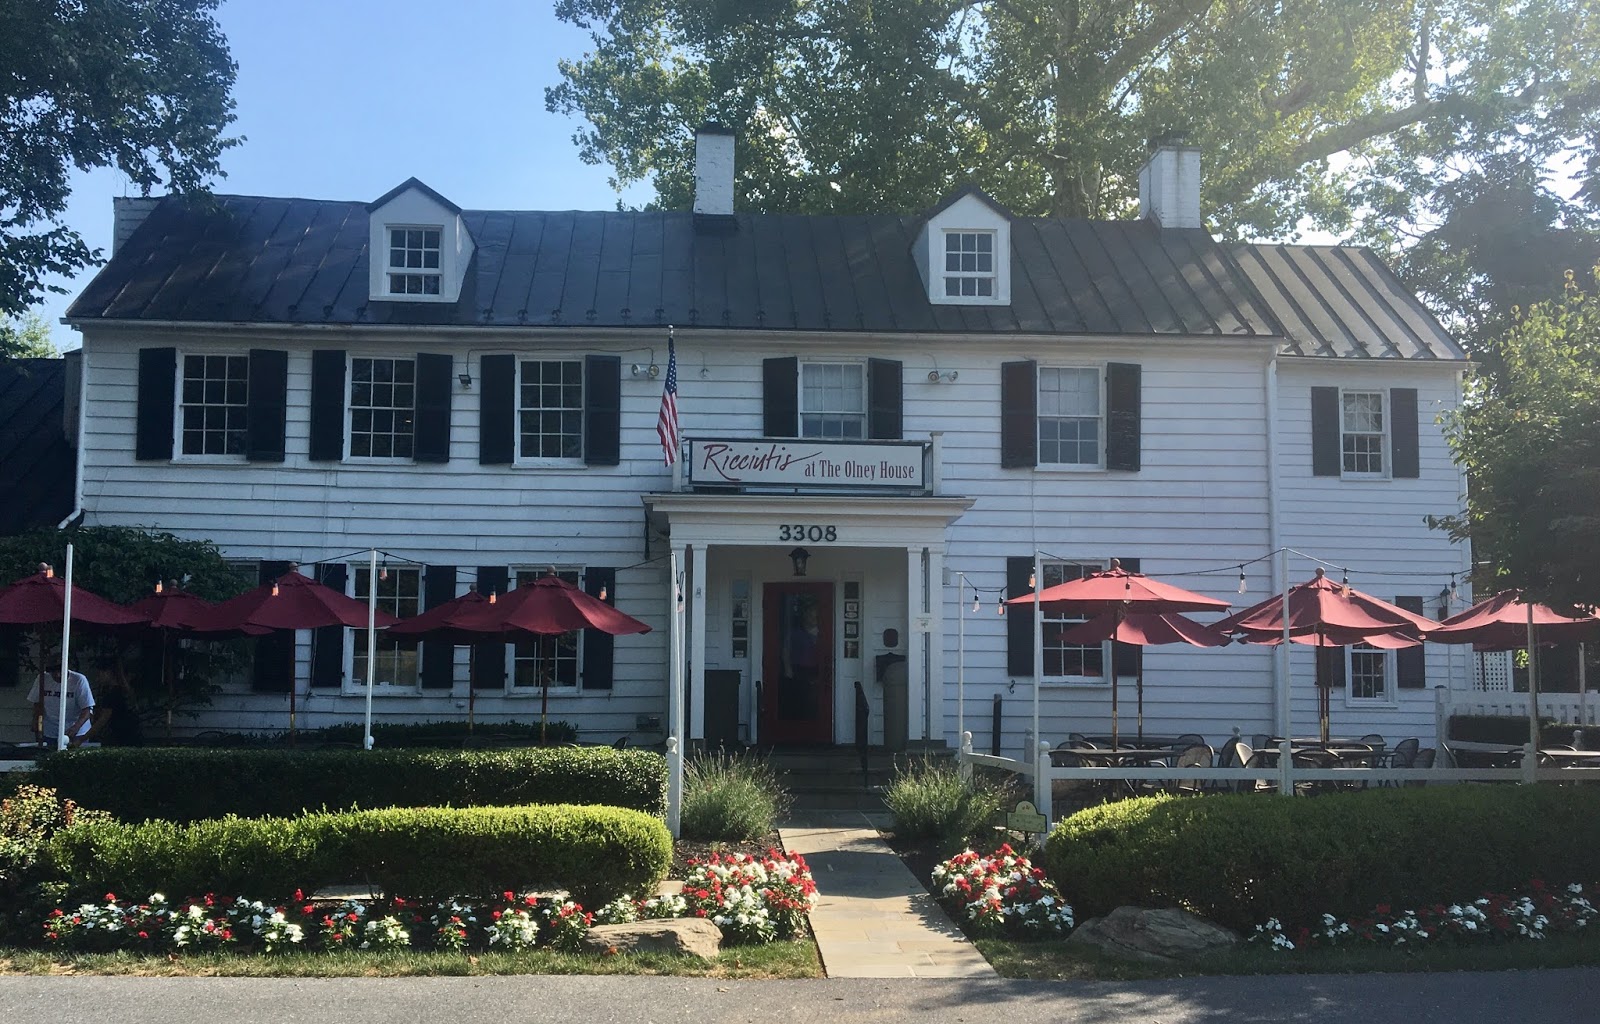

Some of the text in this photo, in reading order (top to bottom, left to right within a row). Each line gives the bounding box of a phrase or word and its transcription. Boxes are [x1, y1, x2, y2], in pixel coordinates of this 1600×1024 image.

[702, 443, 915, 481] Ricciutis at The Olney House
[779, 524, 837, 542] 3308
